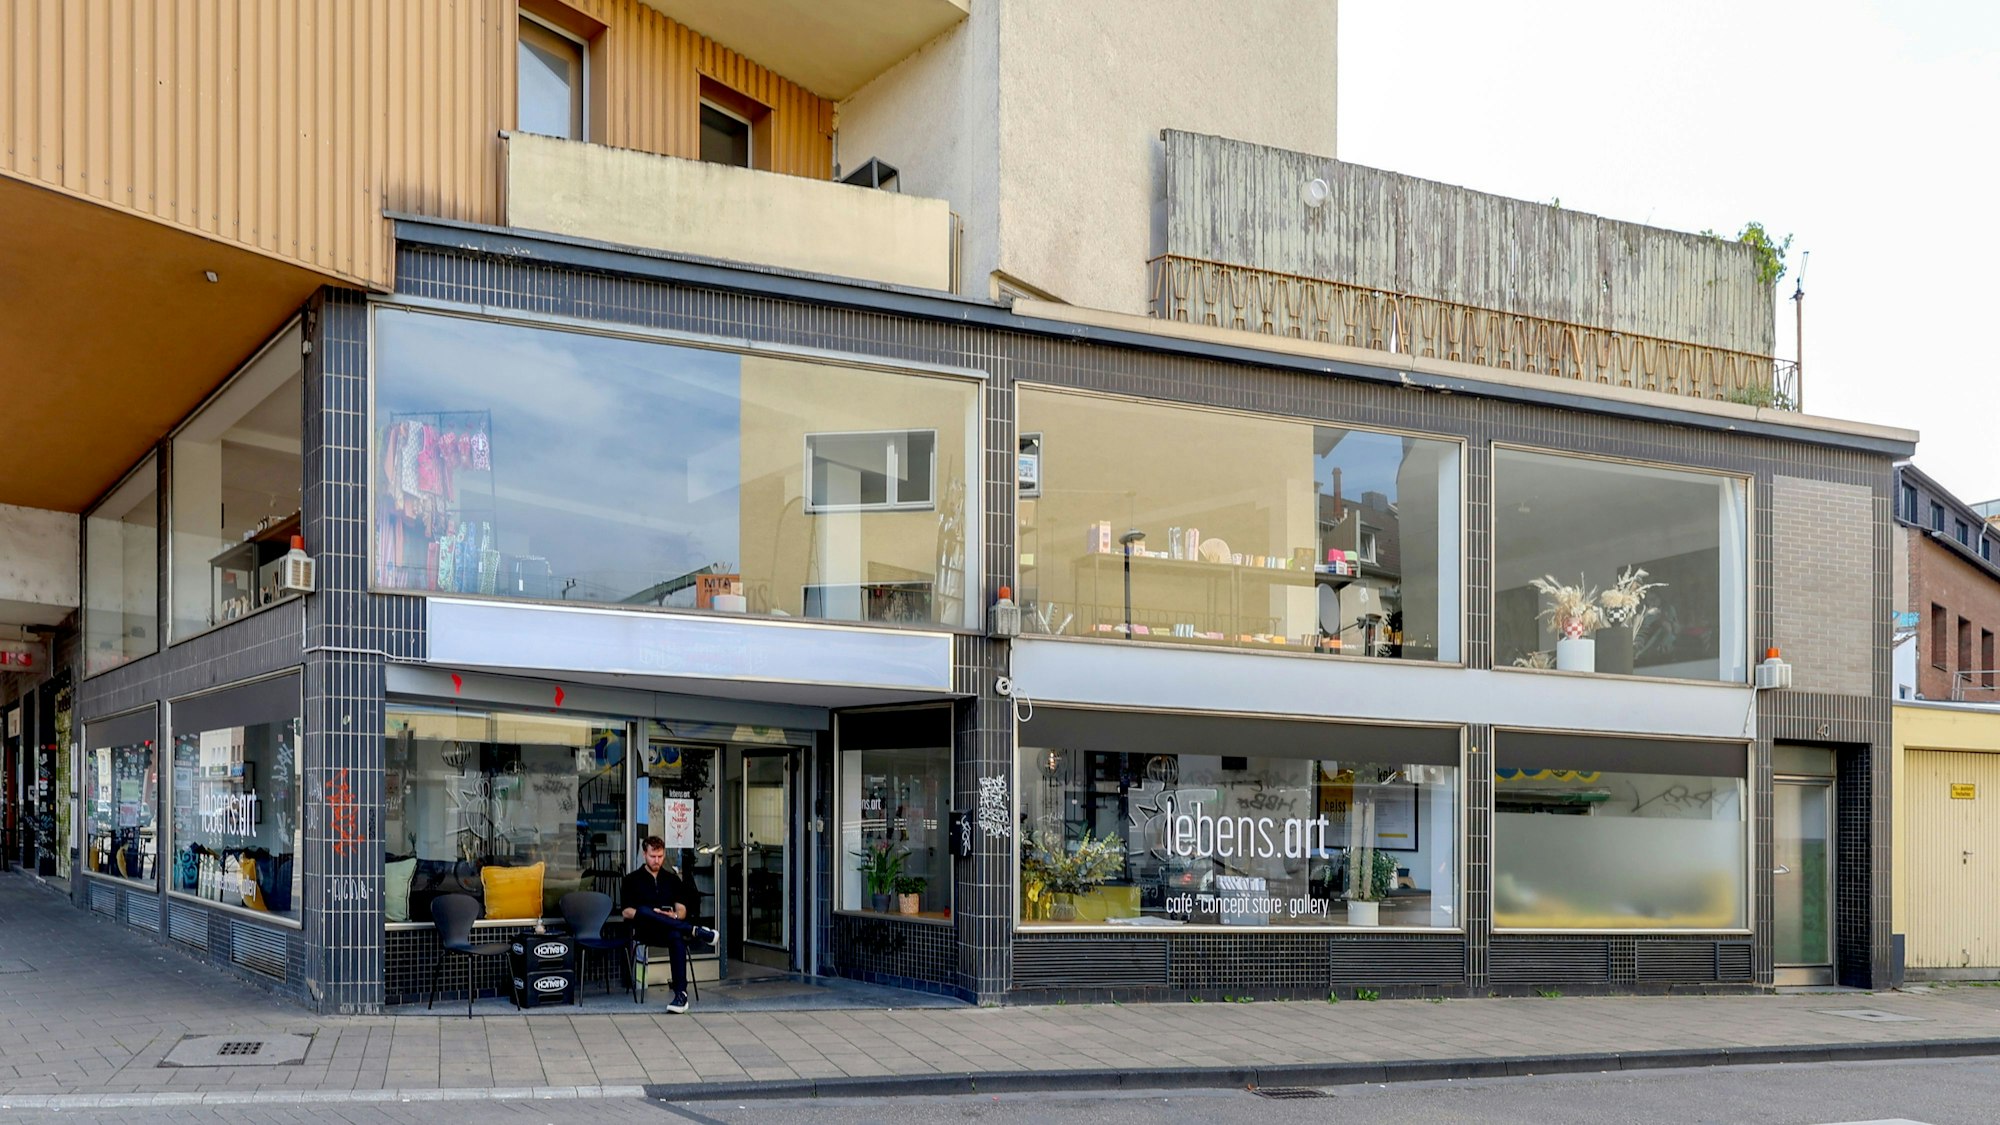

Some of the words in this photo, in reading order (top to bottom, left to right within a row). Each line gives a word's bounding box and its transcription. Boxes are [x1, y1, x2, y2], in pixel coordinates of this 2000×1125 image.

[1816, 724, 1830, 737] 40
[1167, 800, 1329, 859] lebens.art
[1166, 892, 1193, 914] café
[1201, 894, 1250, 917] concept
[1252, 895, 1282, 914] store
[1289, 893, 1329, 918] gallery
